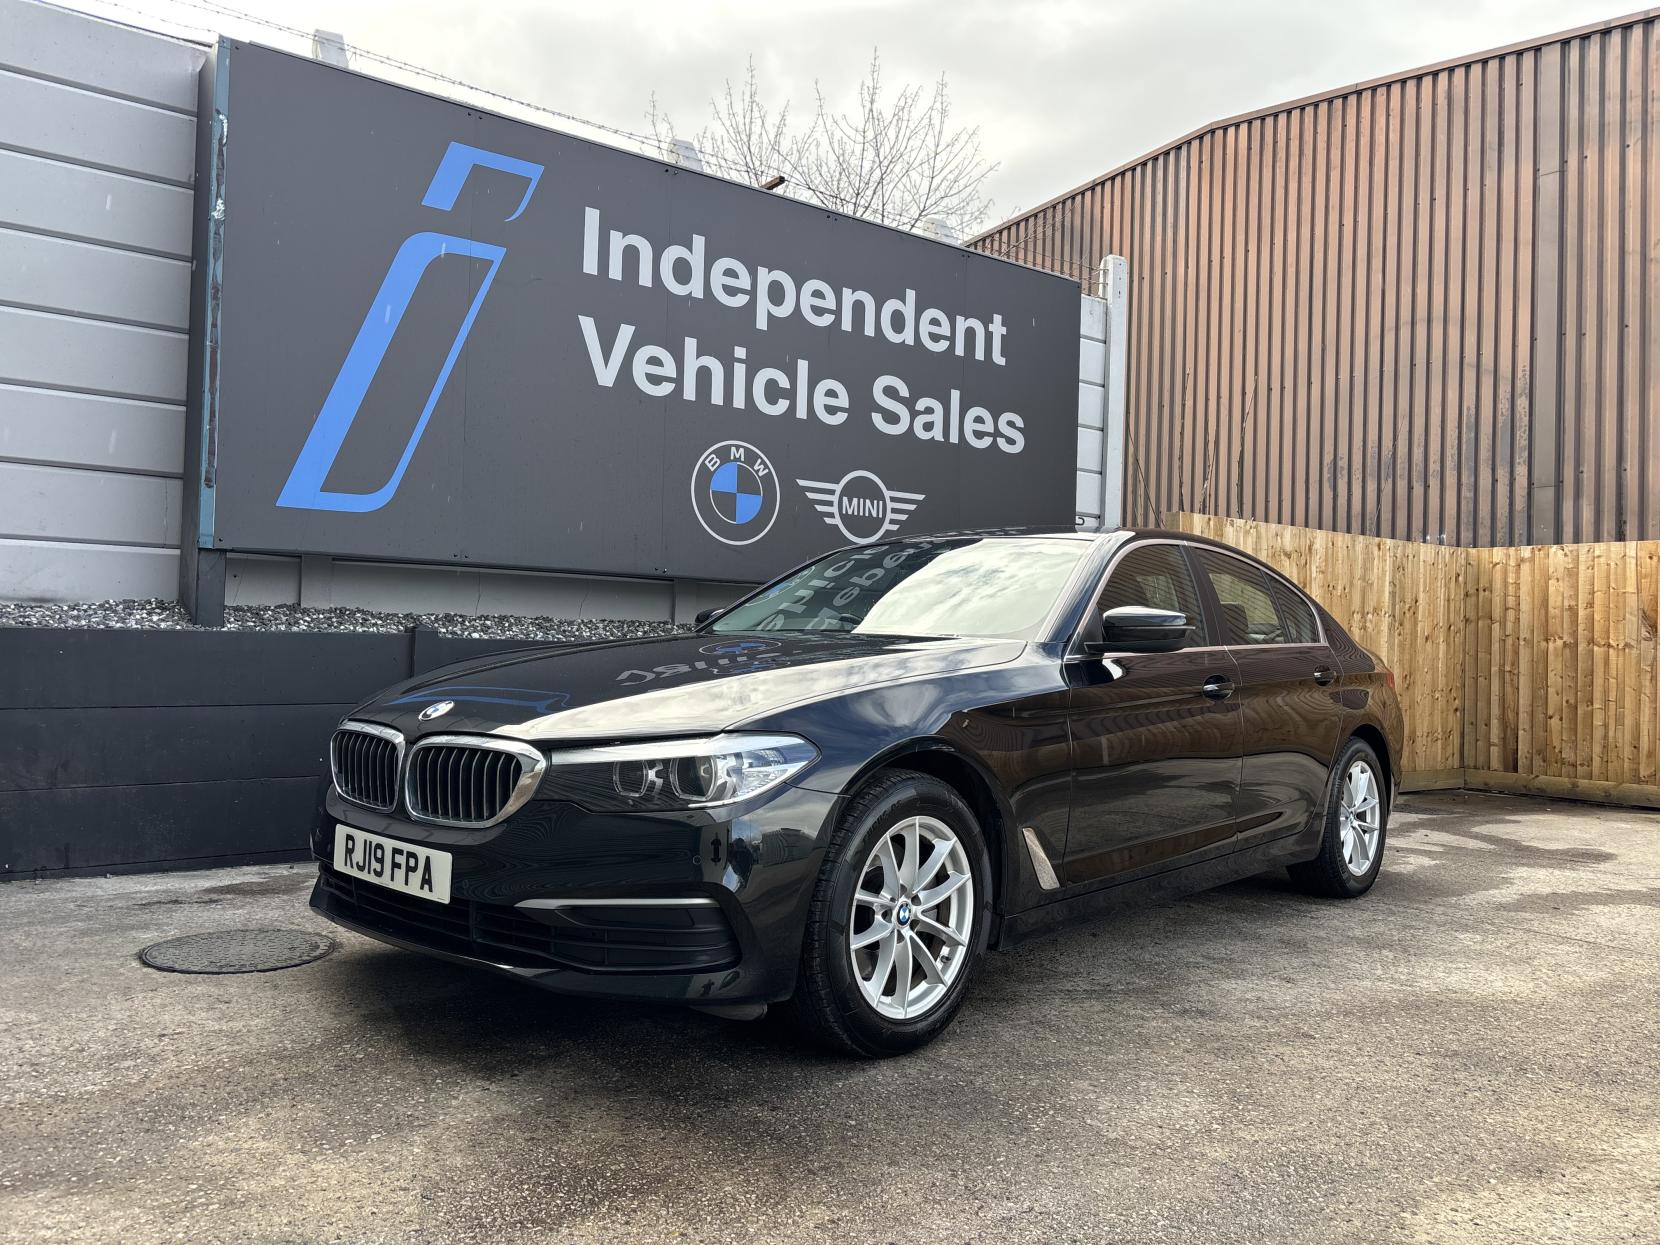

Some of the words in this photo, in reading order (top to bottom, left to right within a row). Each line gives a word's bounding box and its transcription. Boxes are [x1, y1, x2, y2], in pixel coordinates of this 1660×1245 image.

[582, 206, 1007, 366] Independent
[578, 314, 850, 426] Vehicle
[871, 374, 1026, 454] Sales
[704, 446, 769, 477] BMW
[842, 496, 883, 518] MINI
[344, 833, 385, 878] RJ19
[390, 846, 433, 893] FPA
